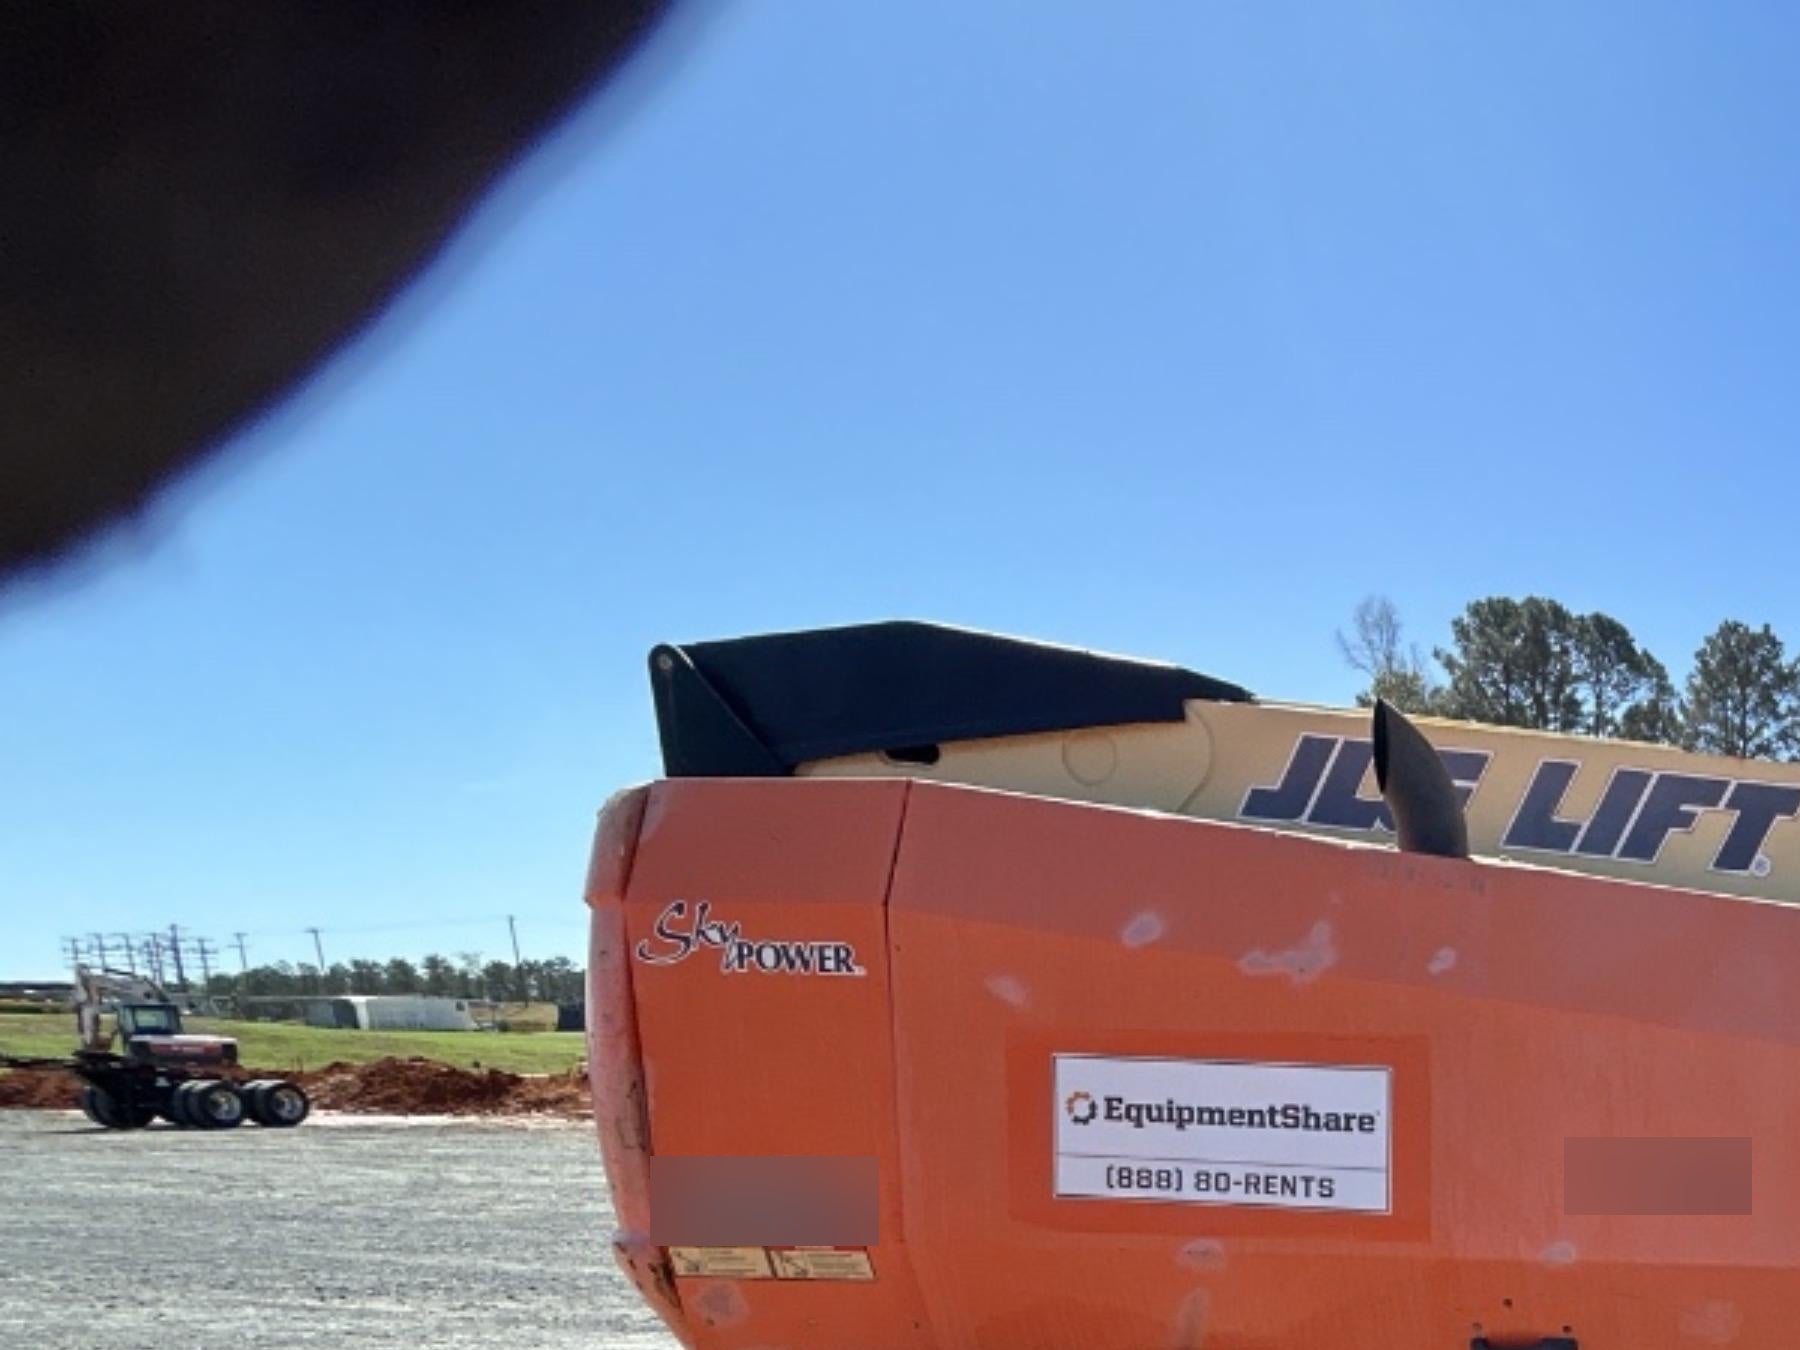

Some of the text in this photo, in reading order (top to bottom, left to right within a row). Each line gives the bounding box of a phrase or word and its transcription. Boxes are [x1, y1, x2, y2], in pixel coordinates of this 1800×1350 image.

[636, 900, 857, 976] Sky POWER
[1103, 1096, 1376, 1133] EquipmentShare
[1106, 1165, 1336, 1198] (888) 80-RENTS
